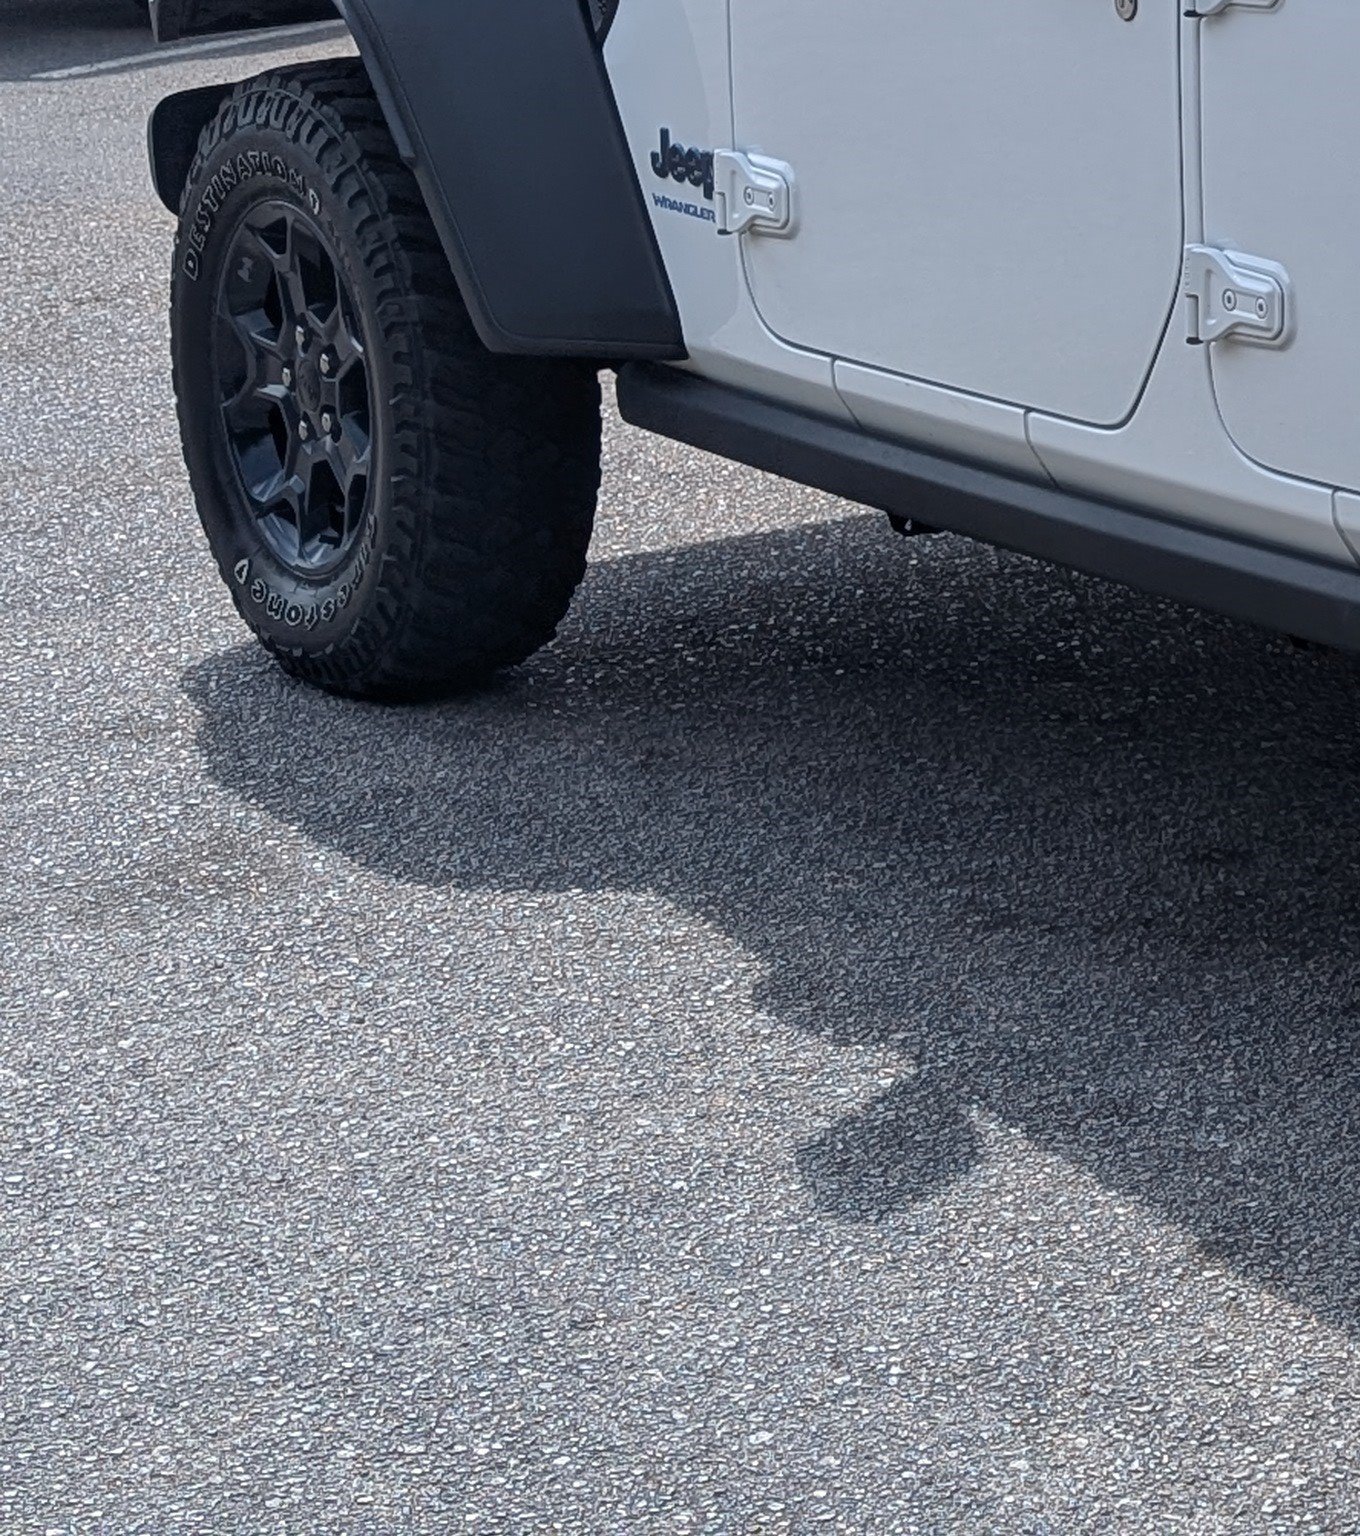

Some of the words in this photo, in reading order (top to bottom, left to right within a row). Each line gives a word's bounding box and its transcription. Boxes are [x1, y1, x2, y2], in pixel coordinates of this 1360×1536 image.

[651, 126, 715, 200] Jeep
[182, 149, 306, 282] DESTINATION
[652, 192, 716, 223] WRANGLER
